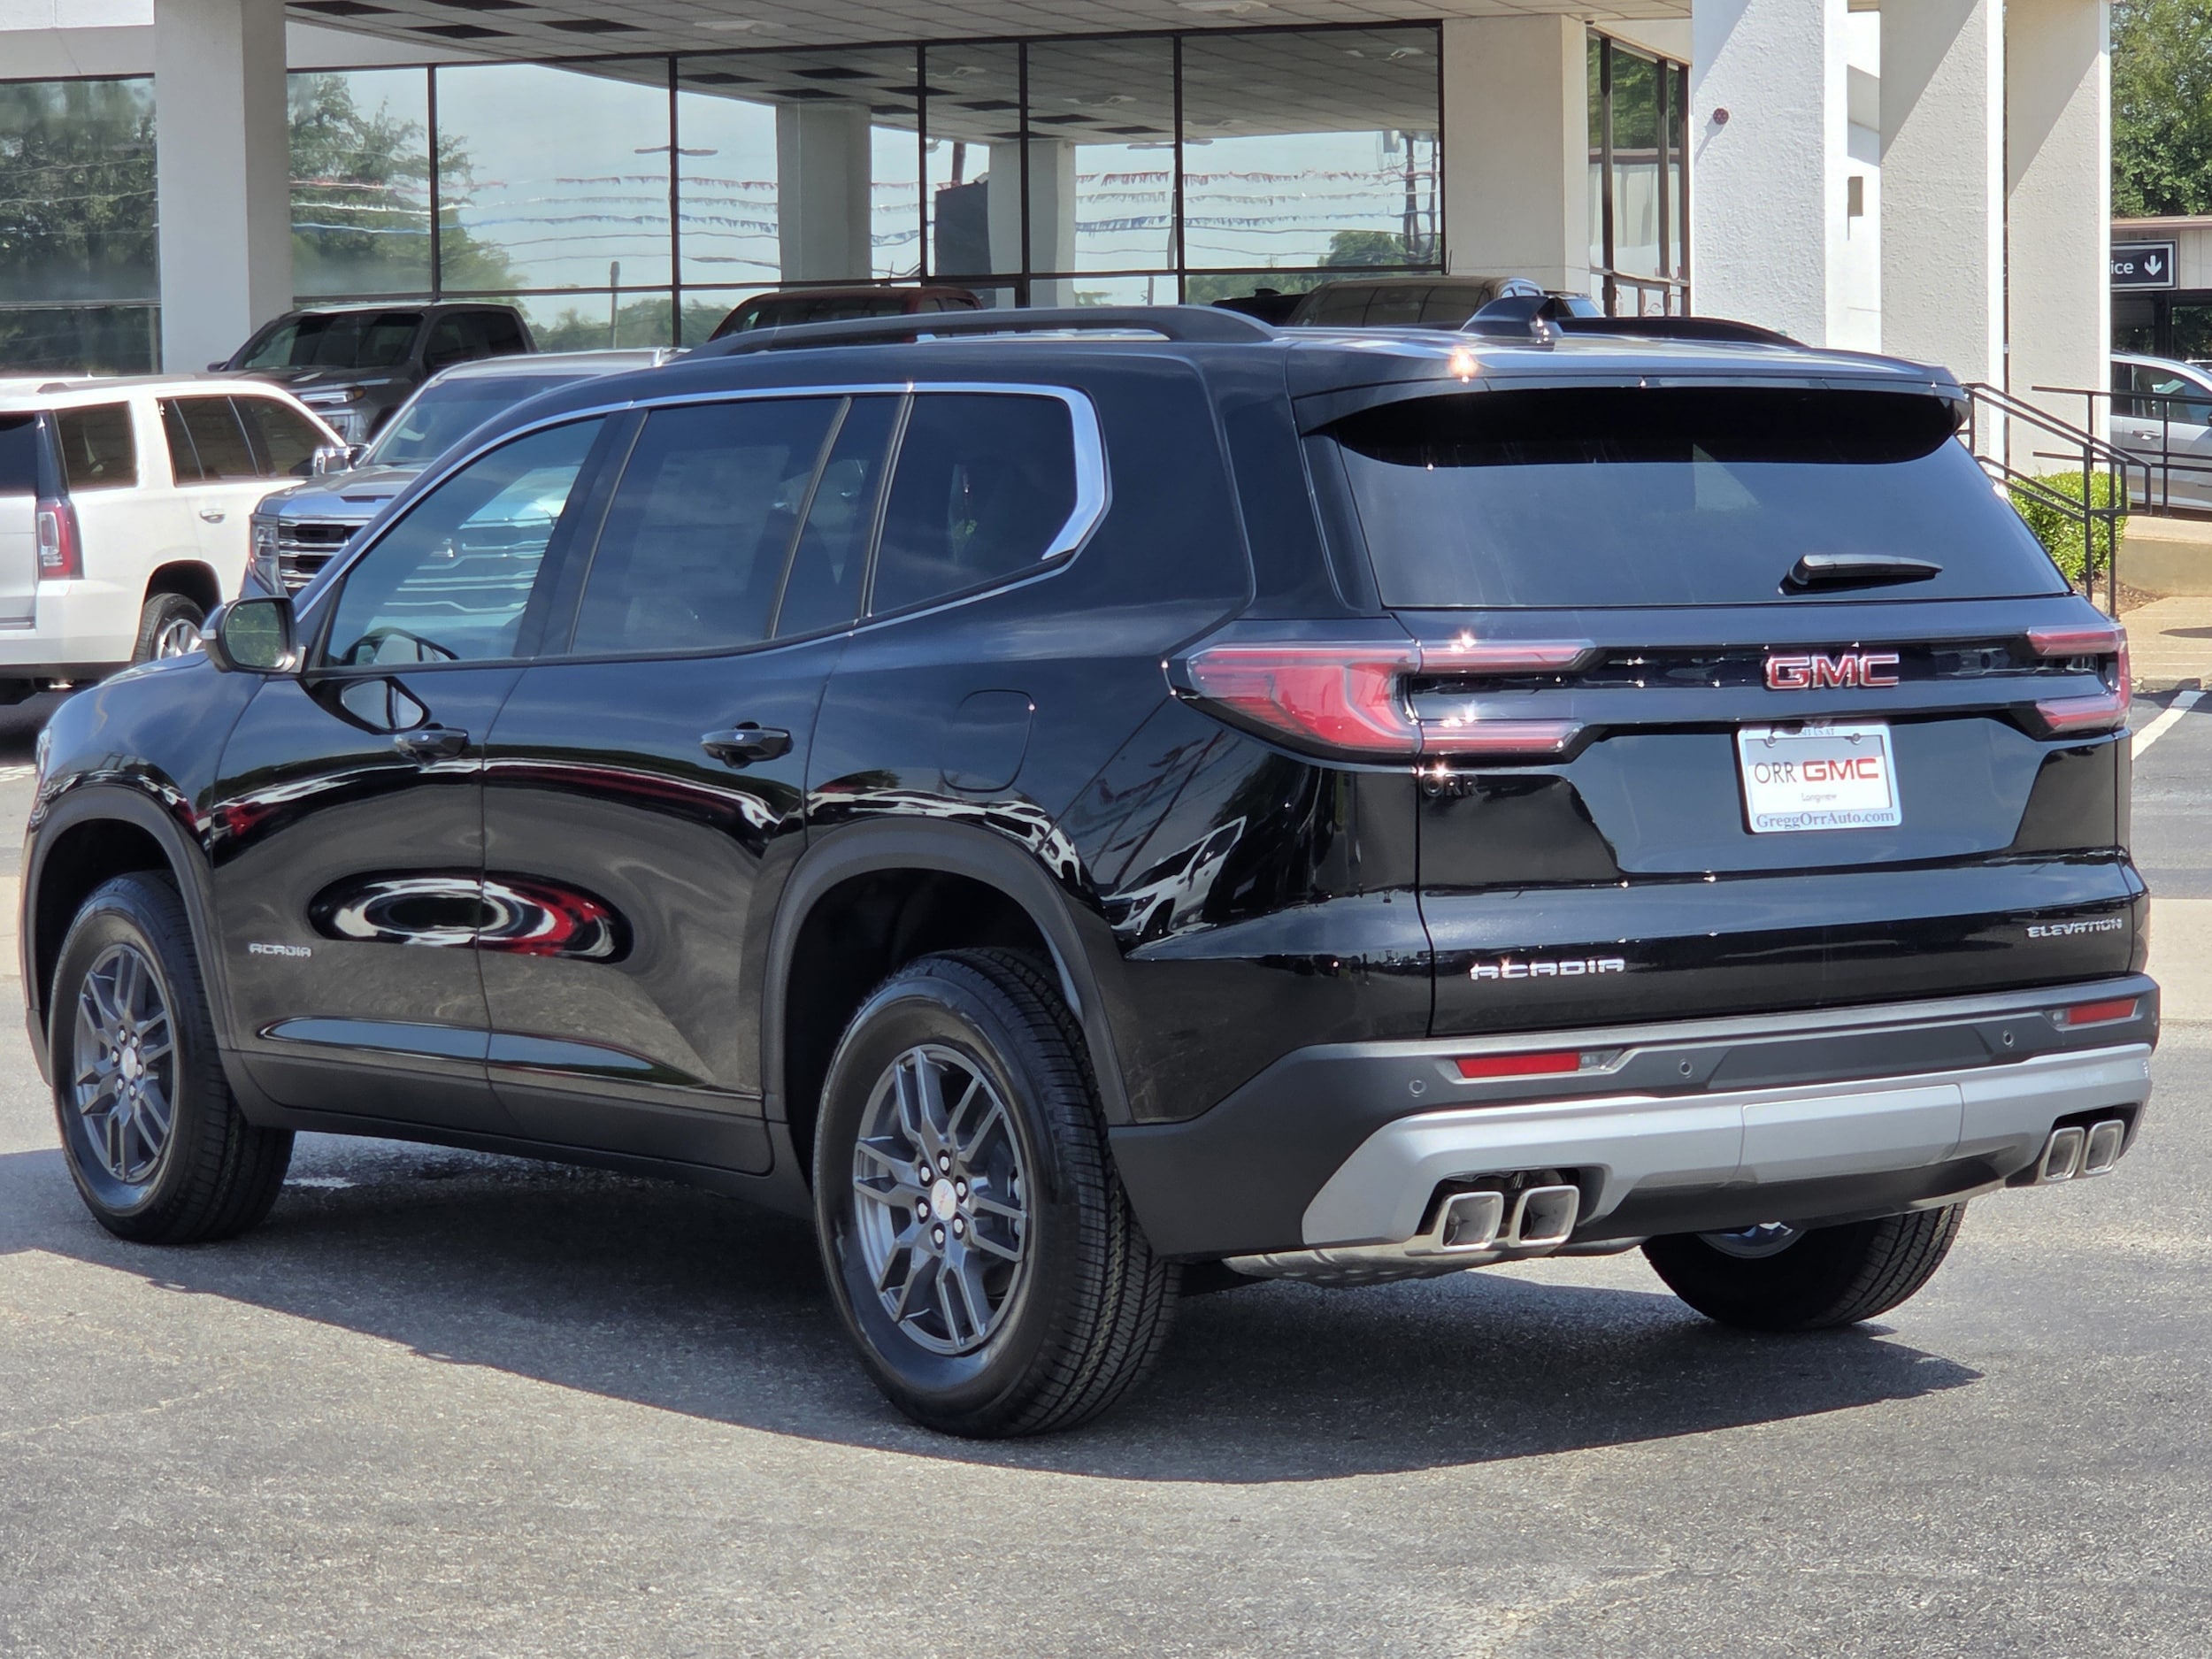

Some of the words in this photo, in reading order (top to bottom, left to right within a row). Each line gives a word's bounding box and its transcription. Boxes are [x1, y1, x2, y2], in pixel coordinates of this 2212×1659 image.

[1766, 653, 1901, 689] GMC
[1755, 762, 1797, 784] ORR
[1802, 758, 1878, 781] GMC
[1423, 773, 1481, 796] ORR
[1756, 811, 1894, 829] GreggOrrAuto.com
[2026, 918, 2123, 938] ELEVATION
[249, 943, 311, 957] ACADIA
[1470, 958, 1625, 980] ACADIA
